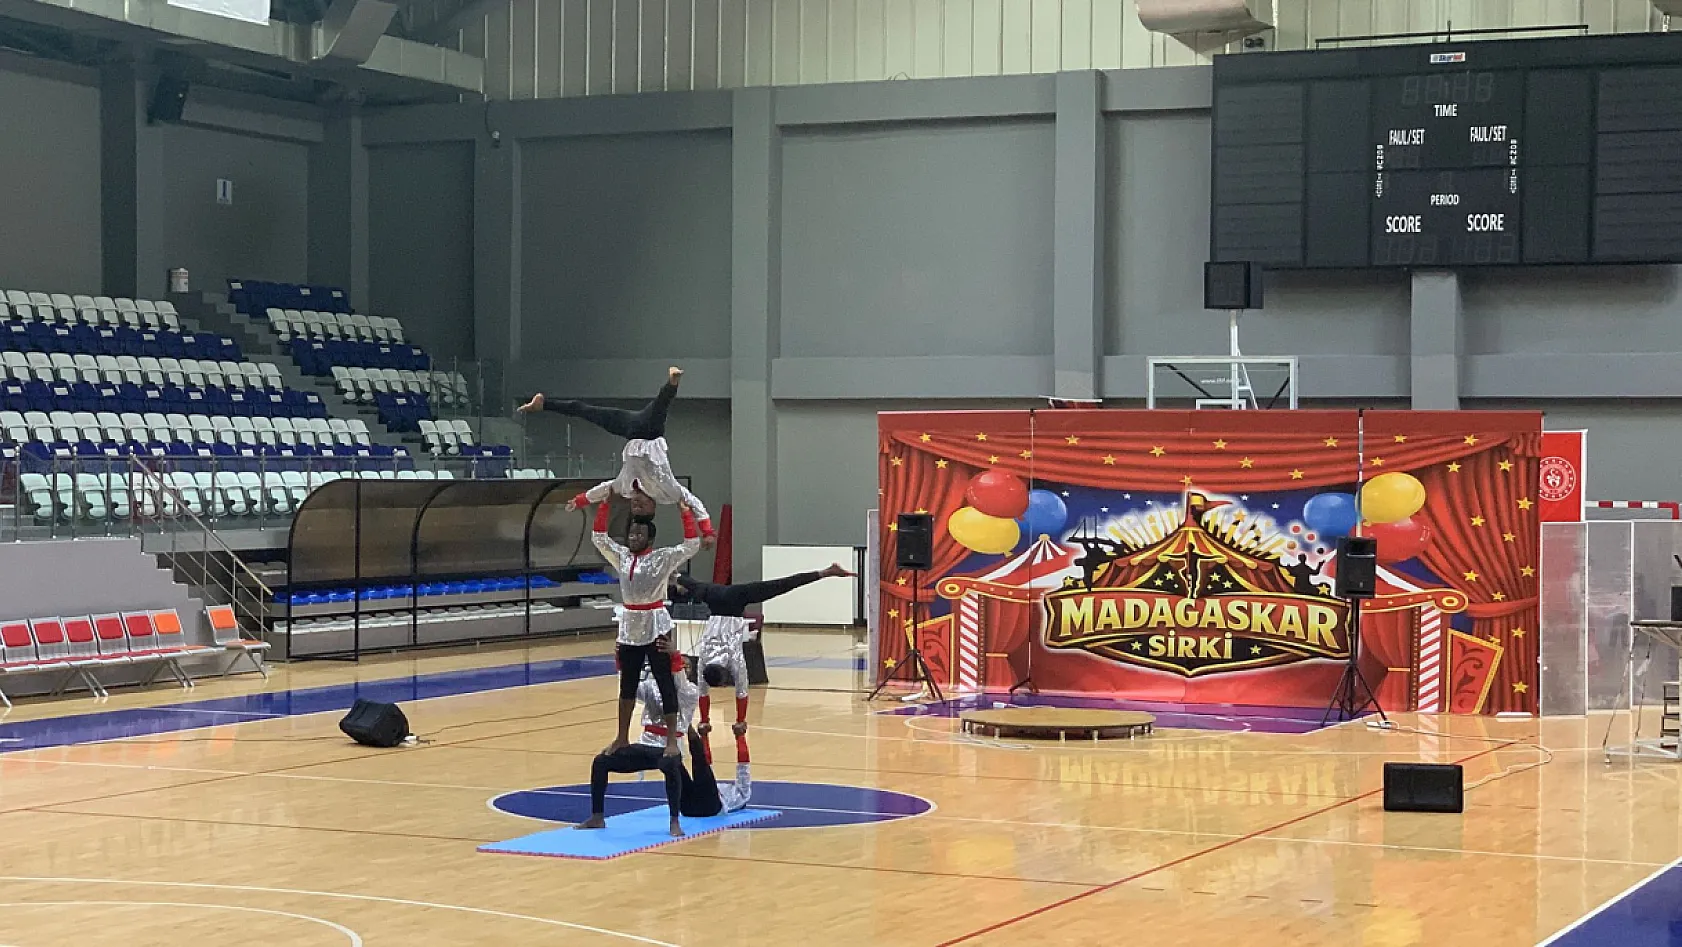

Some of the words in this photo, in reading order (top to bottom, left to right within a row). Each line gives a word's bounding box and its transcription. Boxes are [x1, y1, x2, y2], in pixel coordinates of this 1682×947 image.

[1434, 104, 1458, 117] TIME
[1388, 129, 1425, 145] FAUL/SET
[1470, 126, 1507, 142] FAUL/SET
[1430, 194, 1459, 205] PERIOD
[1385, 215, 1421, 233] SCORE
[1467, 213, 1505, 231] SCORE
[1059, 596, 1340, 649] MADAGASKAR
